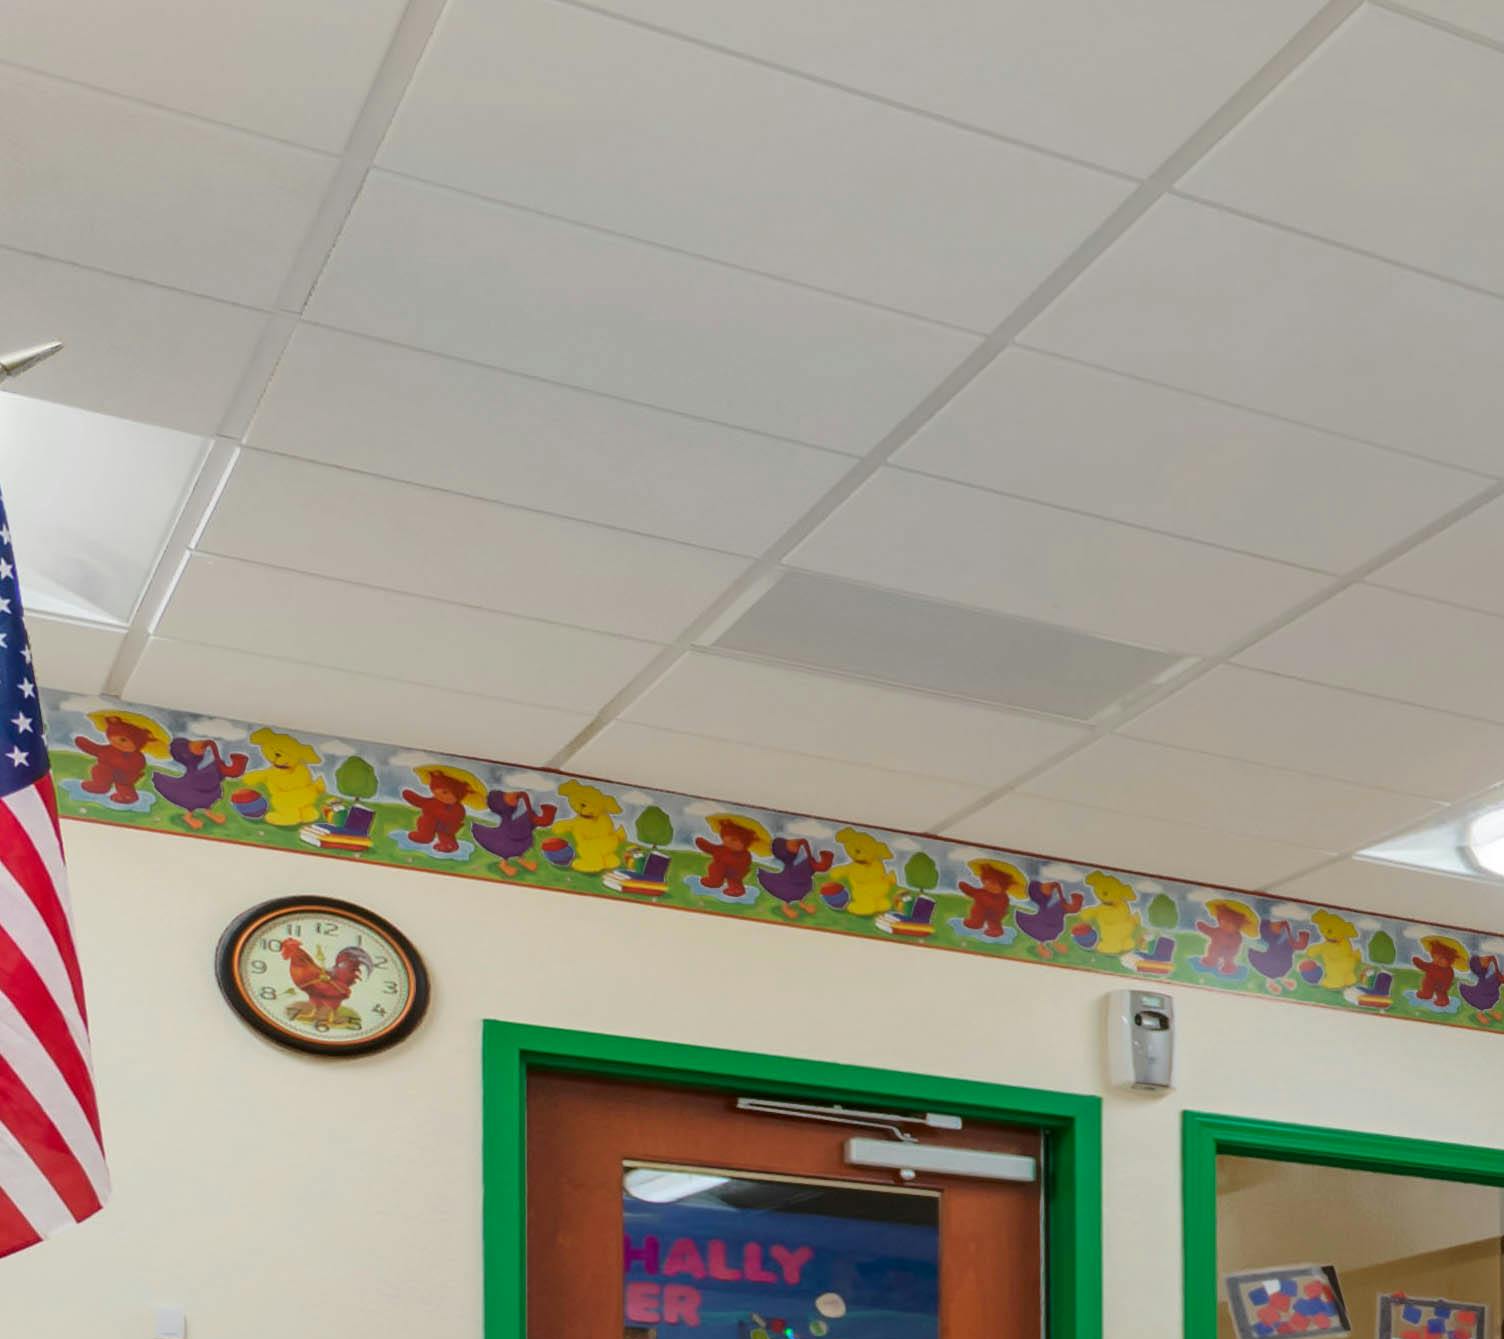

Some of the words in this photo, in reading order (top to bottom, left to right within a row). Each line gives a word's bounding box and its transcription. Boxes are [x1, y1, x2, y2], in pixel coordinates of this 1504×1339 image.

[287, 923, 301, 937] 11
[315, 922, 339, 936] 12
[261, 938, 282, 953] 10
[355, 935, 362, 946] 1
[251, 960, 268, 974] 9
[374, 955, 389, 969] 2
[260, 986, 277, 1000] 8
[383, 981, 398, 995] 3
[372, 1004, 386, 1017] 4
[314, 1021, 330, 1033] 6
